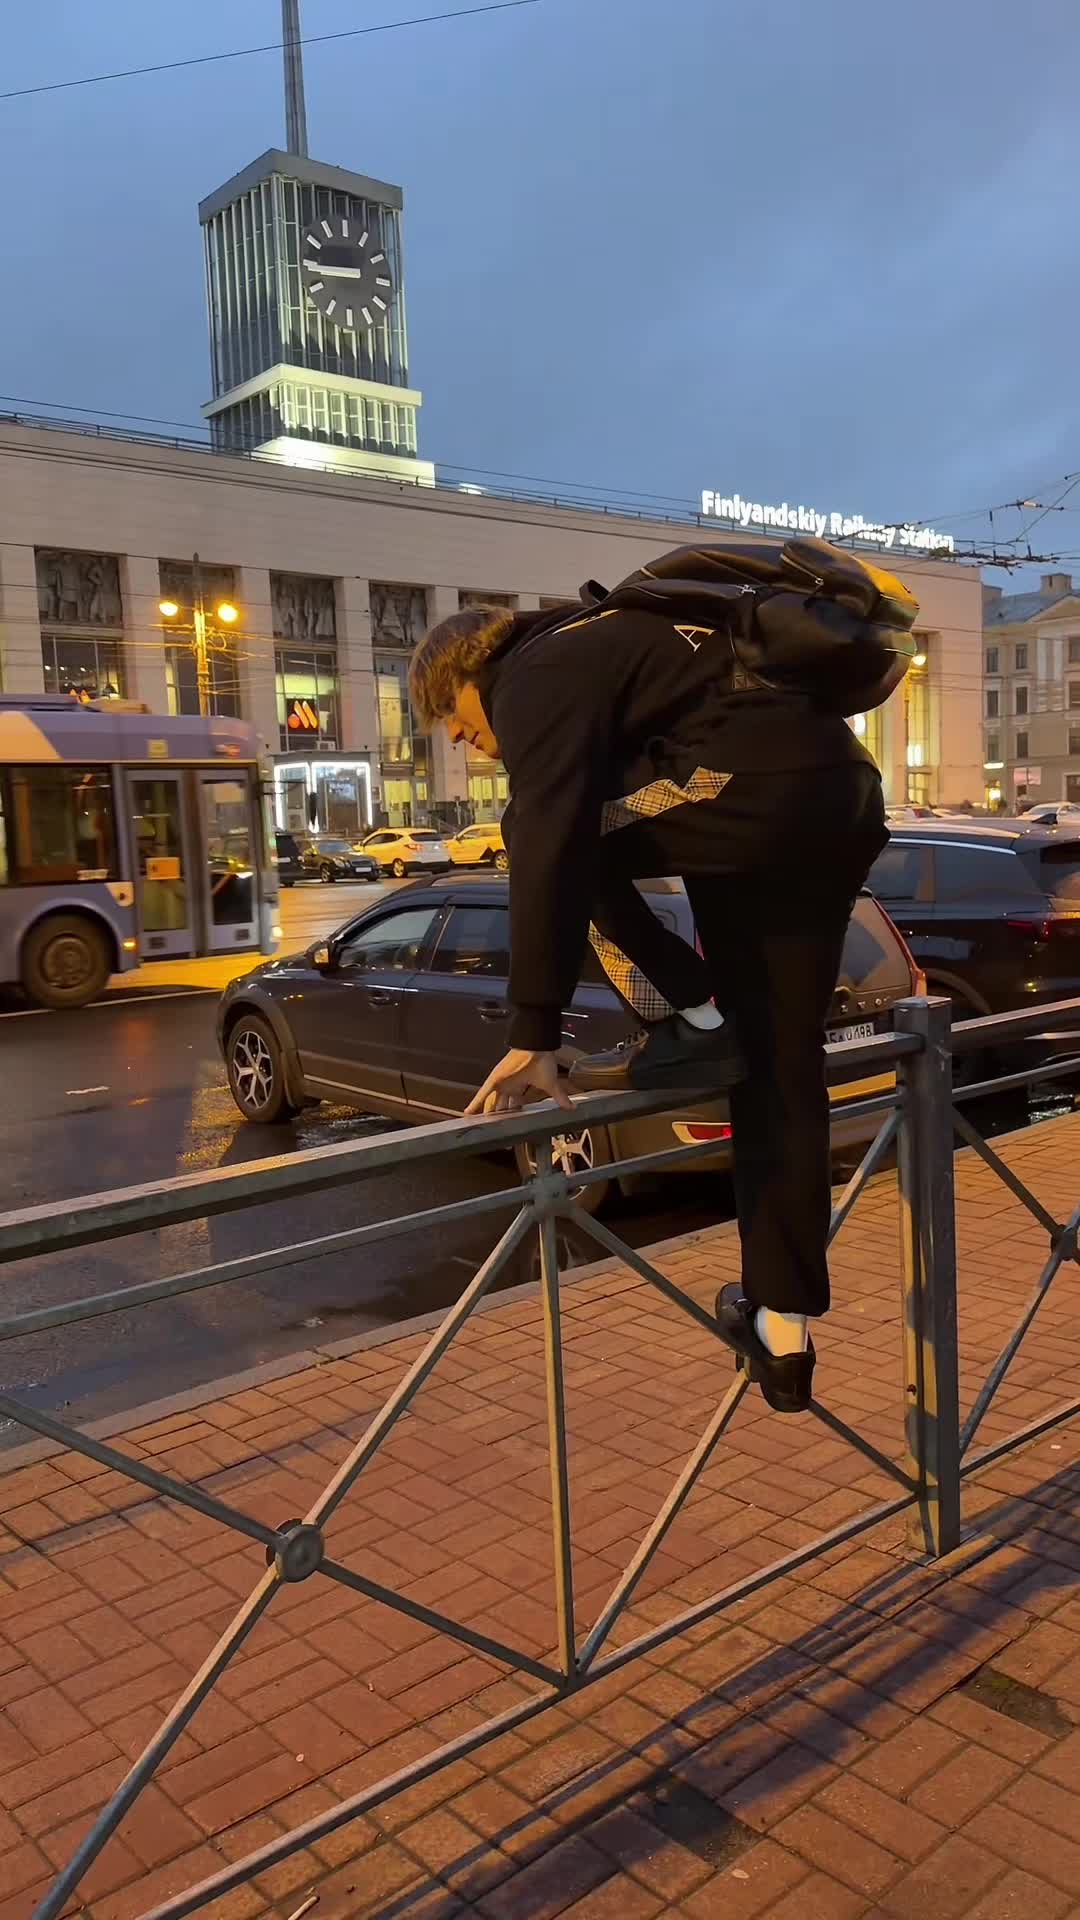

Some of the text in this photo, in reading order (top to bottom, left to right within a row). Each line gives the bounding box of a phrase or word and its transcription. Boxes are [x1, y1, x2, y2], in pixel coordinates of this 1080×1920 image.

[701, 490, 955, 552] Finlyandskiy Railway Station
